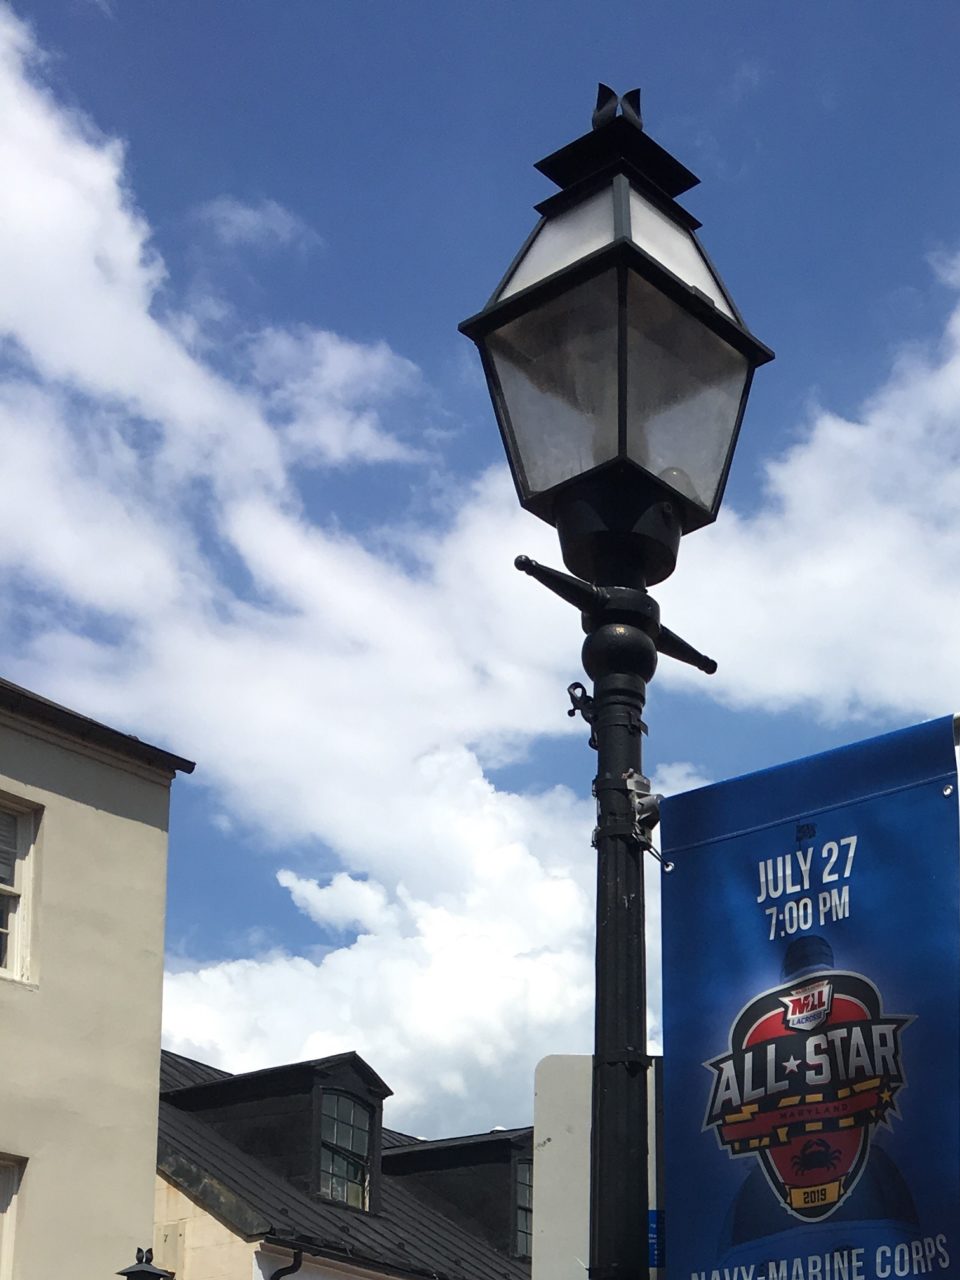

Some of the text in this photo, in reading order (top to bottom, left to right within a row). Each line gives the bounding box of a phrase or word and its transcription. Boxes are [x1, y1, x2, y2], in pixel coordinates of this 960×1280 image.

[757, 835, 858, 904] JULY 27
[765, 886, 849, 941] 7:00 PM
[792, 1010, 823, 1026] LACROSSE
[712, 1024, 898, 1116] ALL STAR
[780, 1103, 849, 1120] MARYLAND
[803, 1188, 827, 1205] 2019
[875, 1233, 951, 1279] CORPS
